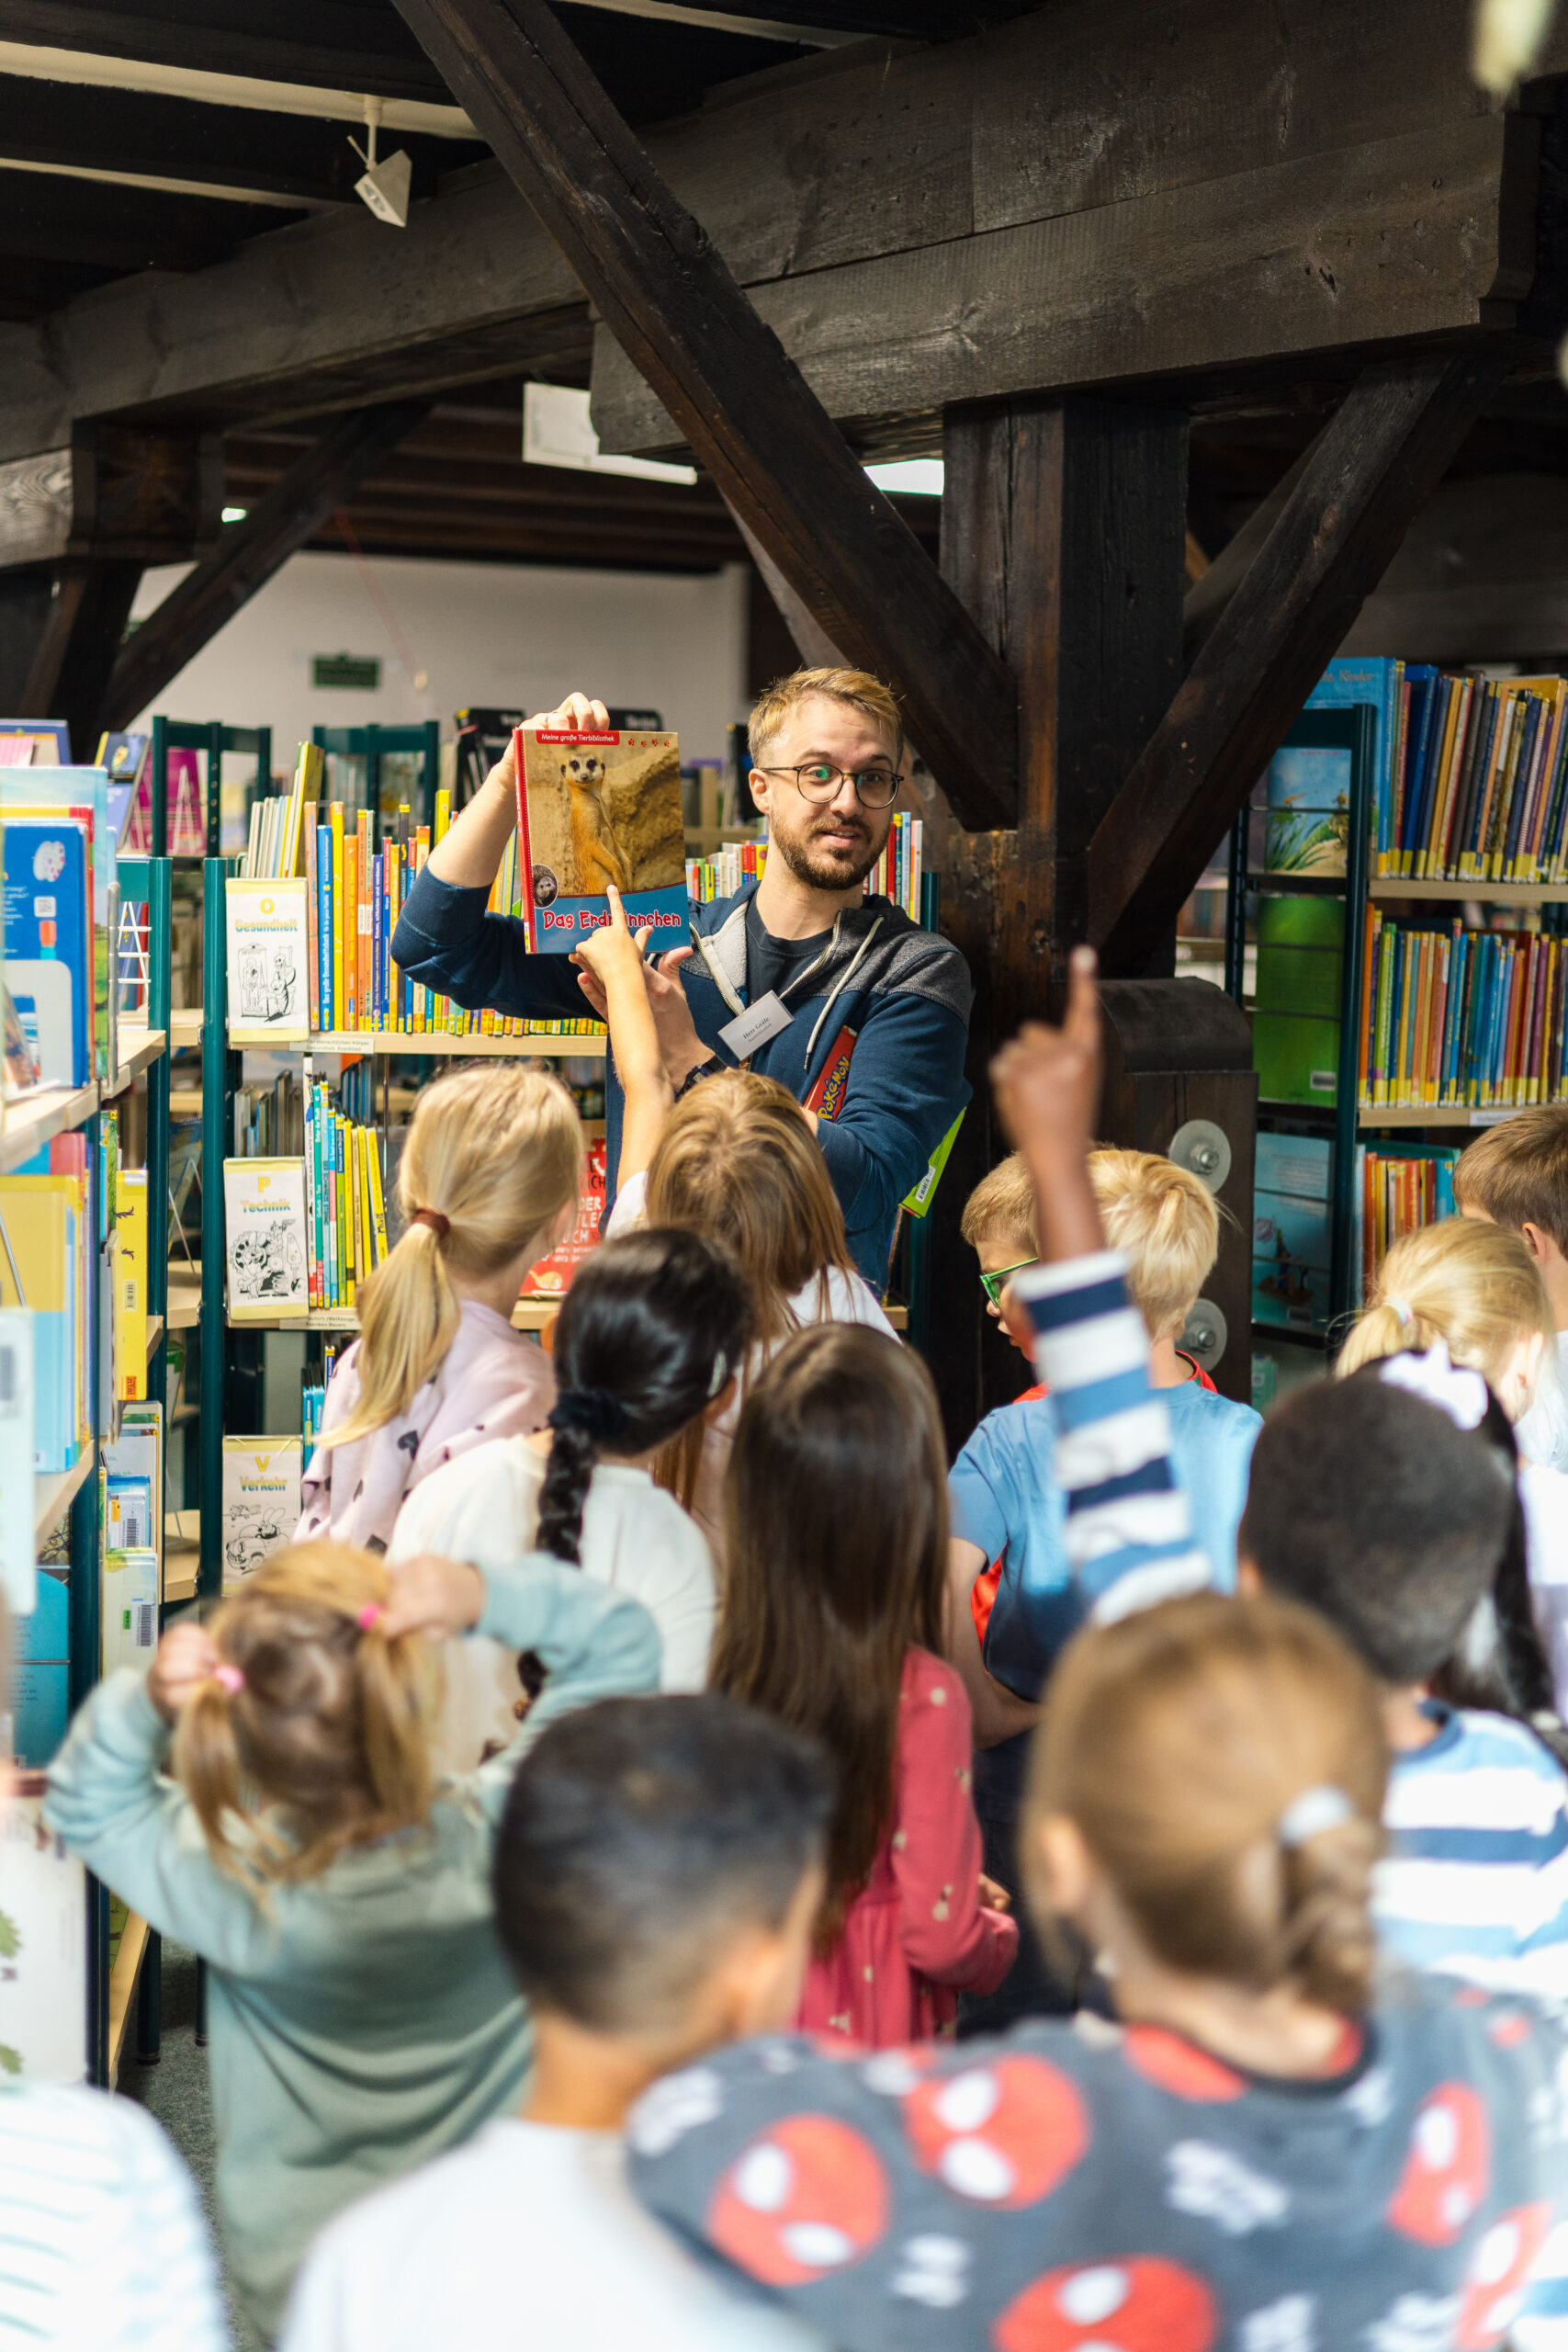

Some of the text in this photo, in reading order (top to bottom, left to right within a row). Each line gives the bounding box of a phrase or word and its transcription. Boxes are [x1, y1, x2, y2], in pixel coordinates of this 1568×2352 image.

[541, 733, 615, 742] Meine große Tierbibliothek
[259, 898, 275, 914] O
[234, 919, 299, 933] Gesundheit
[542, 909, 682, 930] Das Erdnnchen
[742, 1028, 756, 1039] Herr
[257, 1176, 272, 1193] P
[240, 1198, 292, 1213] Technik
[254, 1454, 271, 1473] V
[239, 1476, 288, 1492] Verkehr
